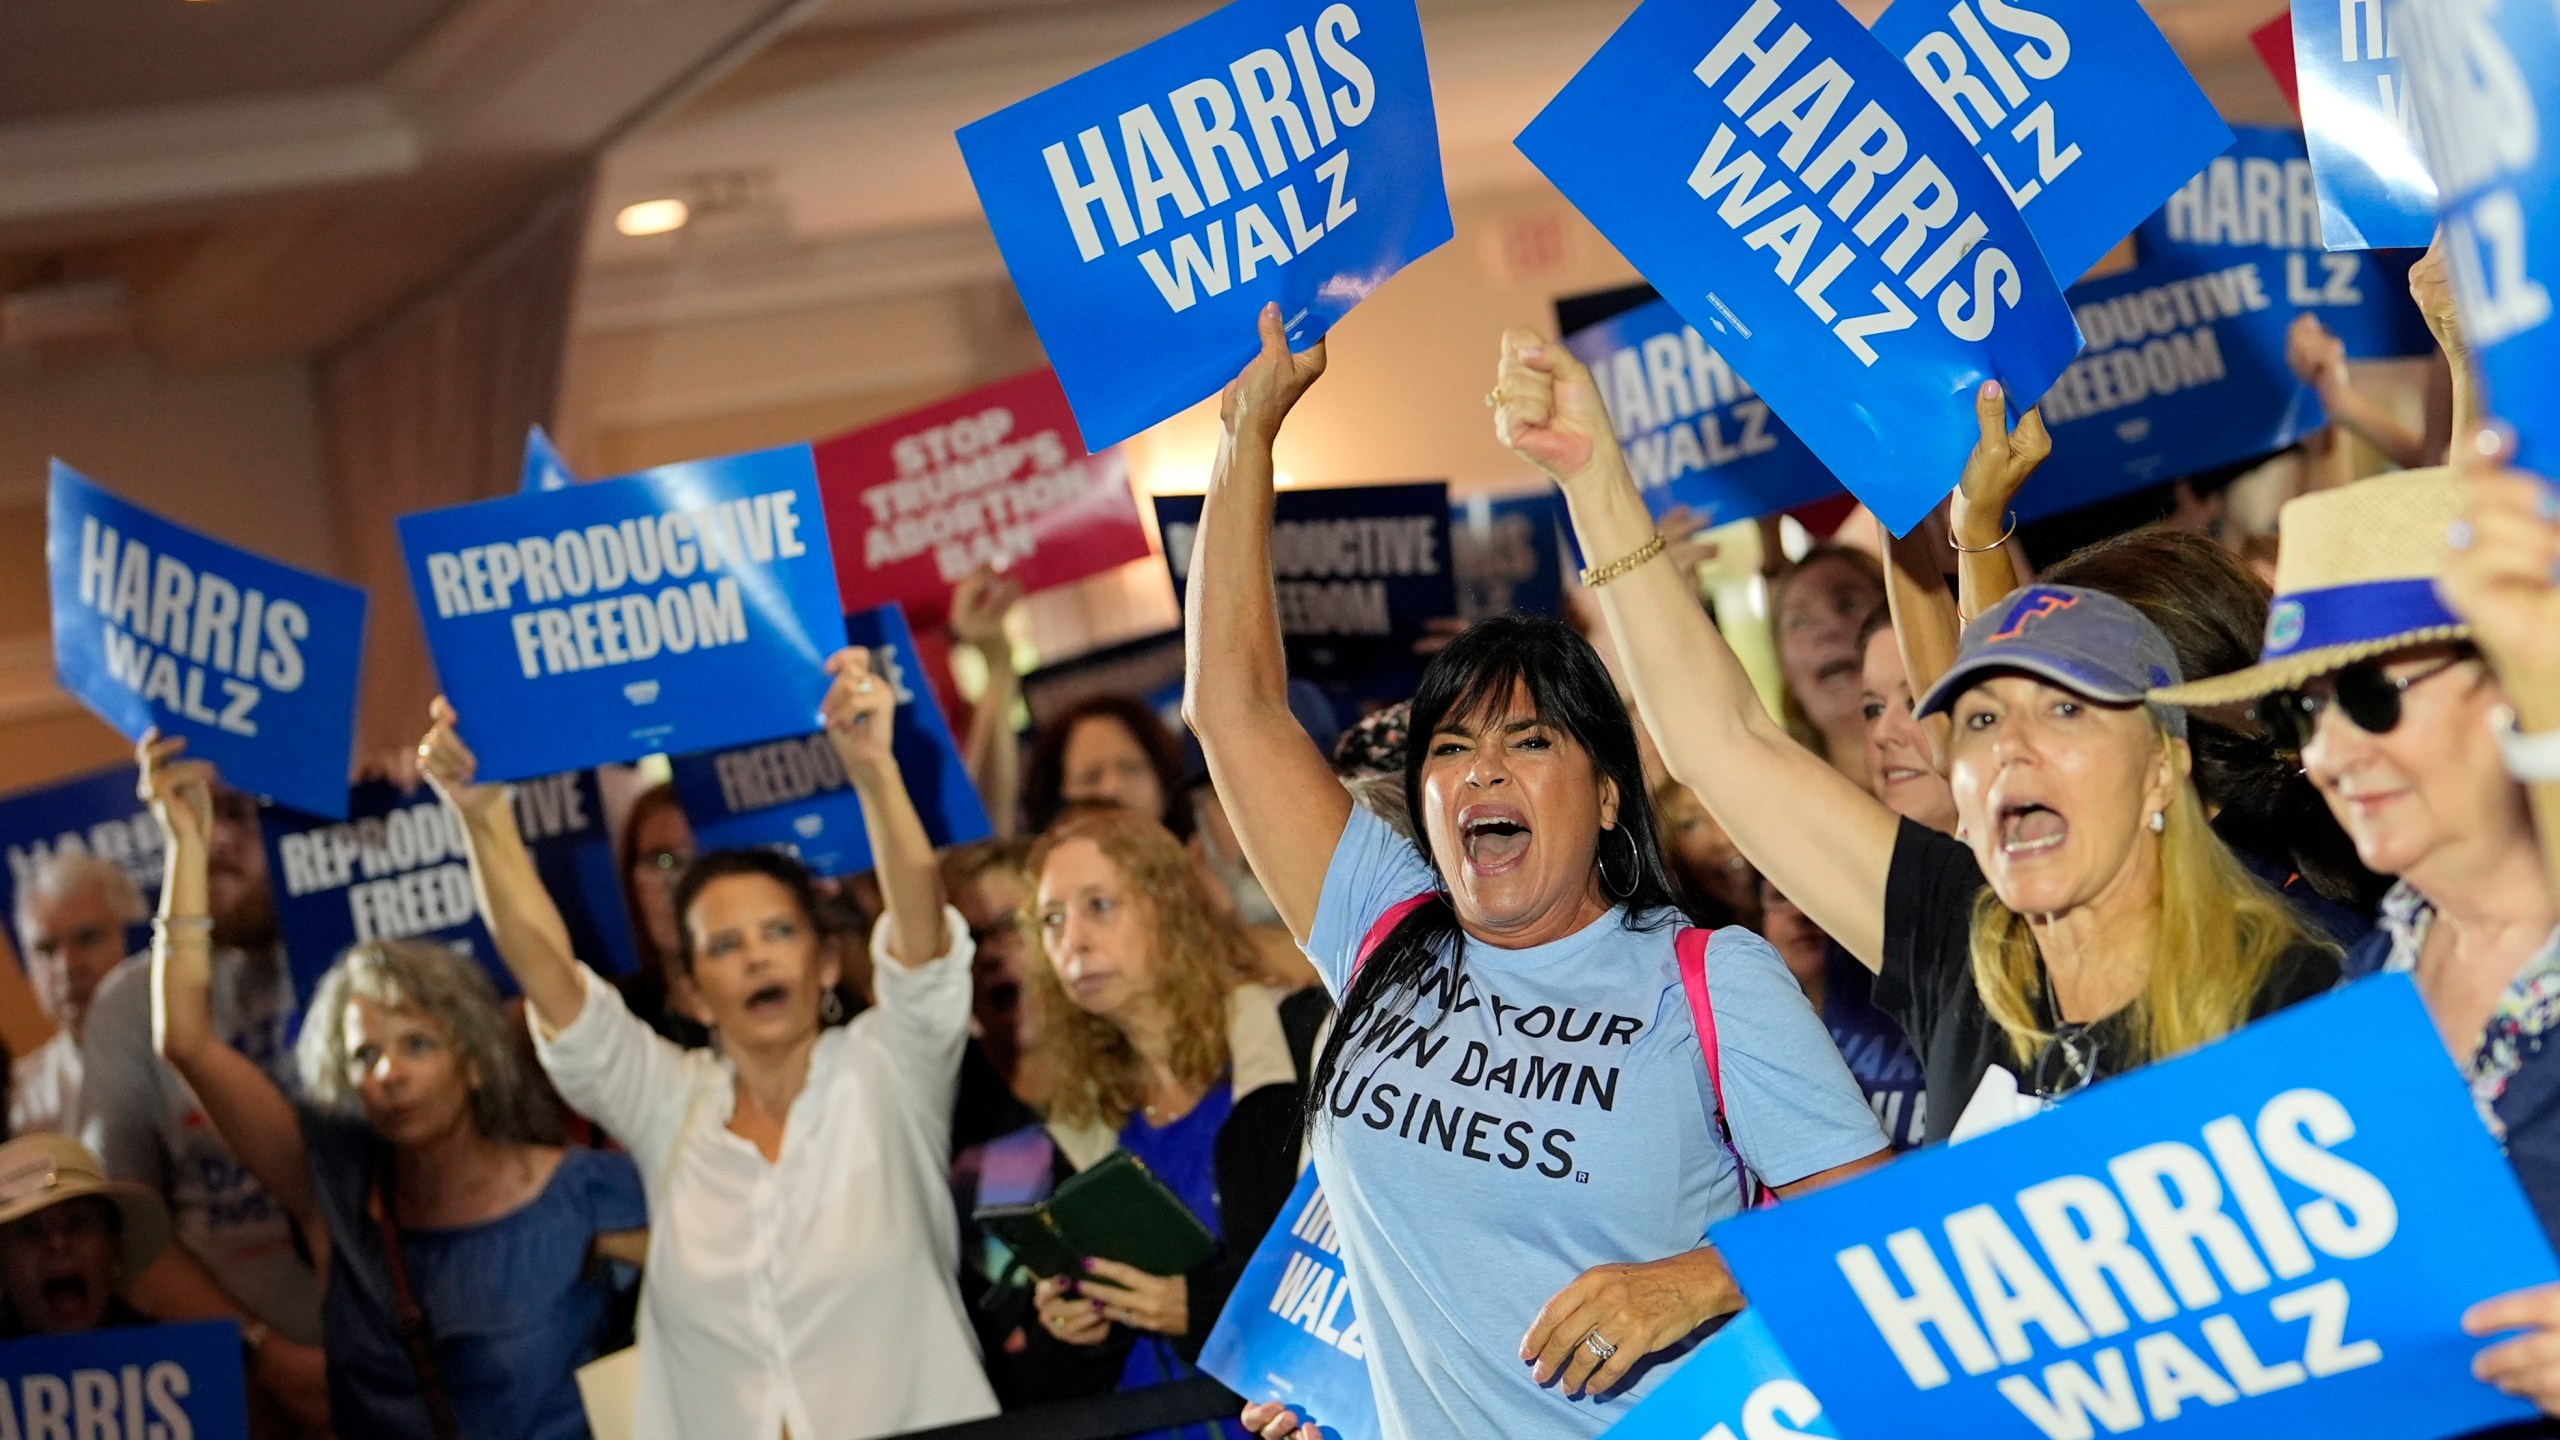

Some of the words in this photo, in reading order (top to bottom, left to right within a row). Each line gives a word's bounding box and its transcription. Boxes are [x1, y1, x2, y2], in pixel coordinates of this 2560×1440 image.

[1042, 3, 1375, 263] HARRIS
[1693, 0, 2021, 342] HARRIS
[1137, 149, 1357, 313] WALZ
[1687, 122, 1918, 367] WALZ
[862, 429, 1066, 523] TRUMP'S
[892, 406, 1015, 474] STOP
[427, 491, 806, 618] REPRODUCTIVE
[866, 462, 1092, 571] ABORTION
[936, 522, 1038, 584] BAN
[80, 515, 309, 693] HARRIS
[512, 577, 748, 679] FREEDOM
[102, 622, 260, 737] WALZ
[1346, 998, 1450, 1069] OWN
[1451, 1041, 1619, 1112] DAMN
[1491, 994, 1644, 1047] YOUR
[1836, 1087, 2399, 1391] HARRIS
[1996, 1278, 2384, 1440] WALZ
